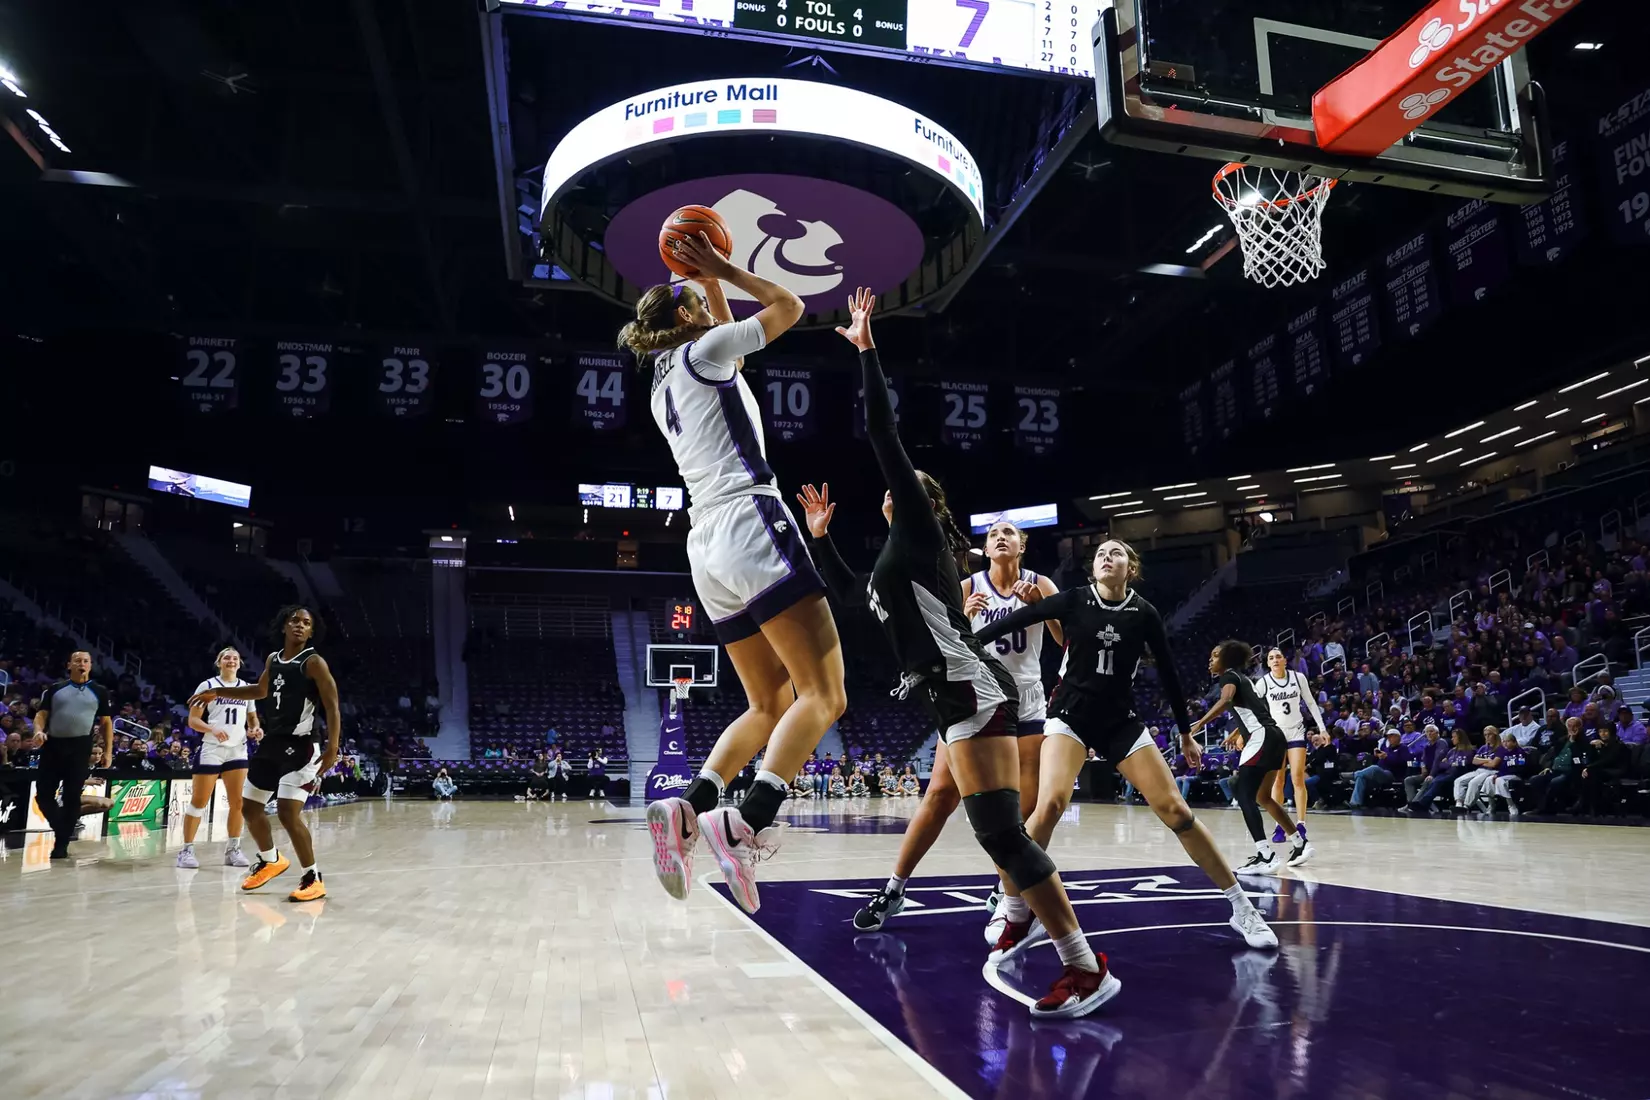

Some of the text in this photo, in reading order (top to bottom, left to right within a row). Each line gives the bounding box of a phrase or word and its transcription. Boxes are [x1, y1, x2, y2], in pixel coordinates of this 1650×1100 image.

[736, 0, 788, 13] BONUS 4
[805, 0, 864, 21] TOL 4
[1045, 0, 1078, 15] 2 0
[776, 14, 863, 37] 0 FOULS 0
[875, 20, 904, 31] BONUS
[955, 0, 990, 48] 7
[1044, 14, 1078, 27] 4 0
[1044, 26, 1077, 40] 7 7
[1042, 39, 1077, 53] 11 0
[1040, 51, 1077, 66] 27 0
[625, 84, 778, 121] Furniture Mall
[914, 117, 969, 171] Furniture
[1613, 130, 1650, 167] FIN
[1386, 233, 1425, 266] K-STATE
[189, 336, 237, 348] BARRETT
[276, 341, 333, 353] KNOSTMAN
[393, 346, 421, 356] PARR
[486, 351, 527, 362] BOOZER
[182, 349, 237, 388] 22
[578, 356, 624, 368] MURRELL
[275, 353, 328, 393] 33
[378, 357, 430, 394] 33
[479, 363, 531, 400] 30
[766, 368, 812, 380] WILLIAMS
[576, 369, 625, 407] 44
[940, 381, 989, 393] BLACKMAN
[1014, 386, 1061, 397] RICHMOND
[766, 381, 811, 417] 10
[664, 385, 684, 438] 4
[944, 393, 987, 429] 25
[1017, 397, 1060, 434] 23
[608, 492, 623, 503] 21
[665, 495, 673, 505] 7
[671, 613, 690, 630] 24
[994, 629, 1028, 656] 50
[1095, 648, 1114, 676] 11
[1269, 690, 1299, 702] Wildcats
[224, 707, 238, 725] 11
[1281, 701, 1292, 715] 3
